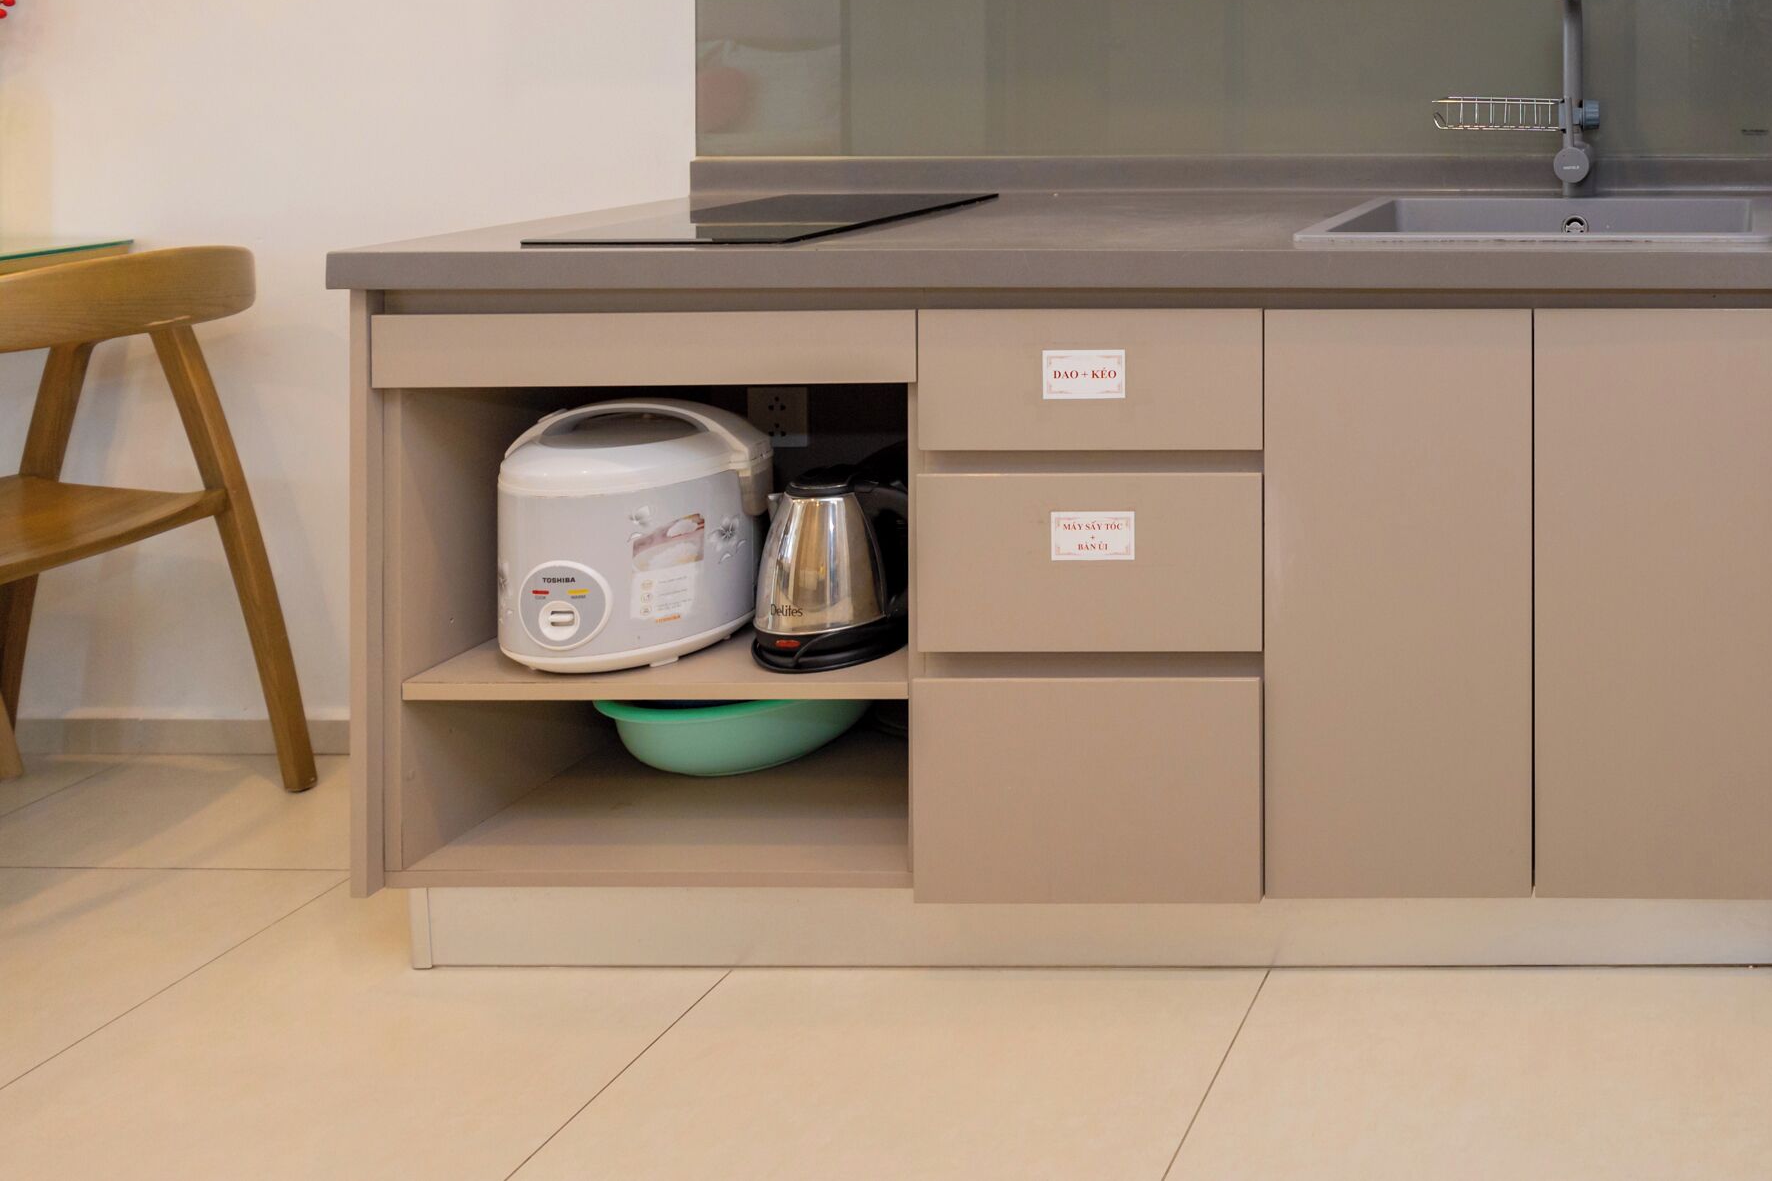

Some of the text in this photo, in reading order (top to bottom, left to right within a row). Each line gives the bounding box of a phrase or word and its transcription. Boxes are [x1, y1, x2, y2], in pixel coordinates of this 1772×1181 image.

[1053, 370, 1079, 379] DAO
[1091, 367, 1117, 379] KÉO
[1063, 520, 1122, 530] MÁY SẤY TÓC
[1078, 542, 1096, 550] BÀN
[771, 604, 803, 617] Delites
